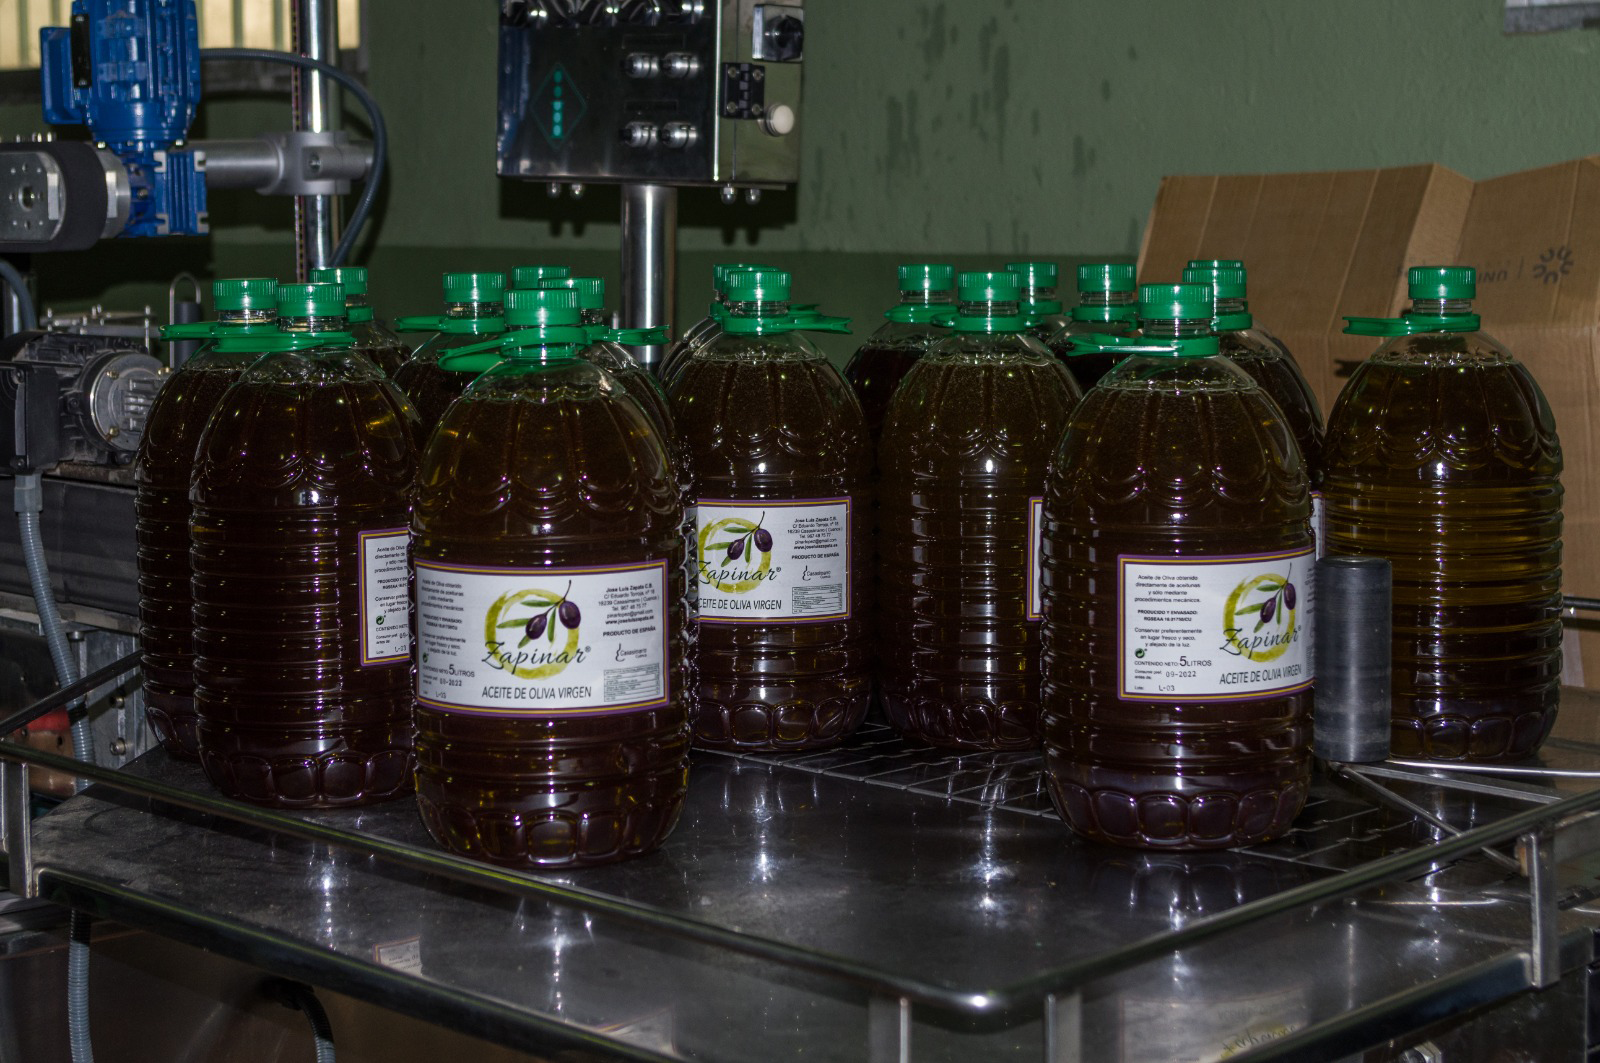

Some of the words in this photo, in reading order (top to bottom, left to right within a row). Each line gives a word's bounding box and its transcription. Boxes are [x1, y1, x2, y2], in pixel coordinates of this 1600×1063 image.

[698, 598, 716, 609] CEITE
[718, 599, 728, 609] DE
[730, 599, 751, 610] OLIVA
[754, 599, 782, 610] VIRGEN
[1220, 672, 1248, 685] ACEITE
[1250, 671, 1261, 682] DE
[1262, 669, 1281, 681] OLIVA
[1282, 664, 1302, 677] VIRGEN
[482, 686, 512, 699] ACEITE
[514, 687, 526, 699] DE
[529, 687, 556, 699] OLIVA
[558, 686, 592, 699] VIRGEN
